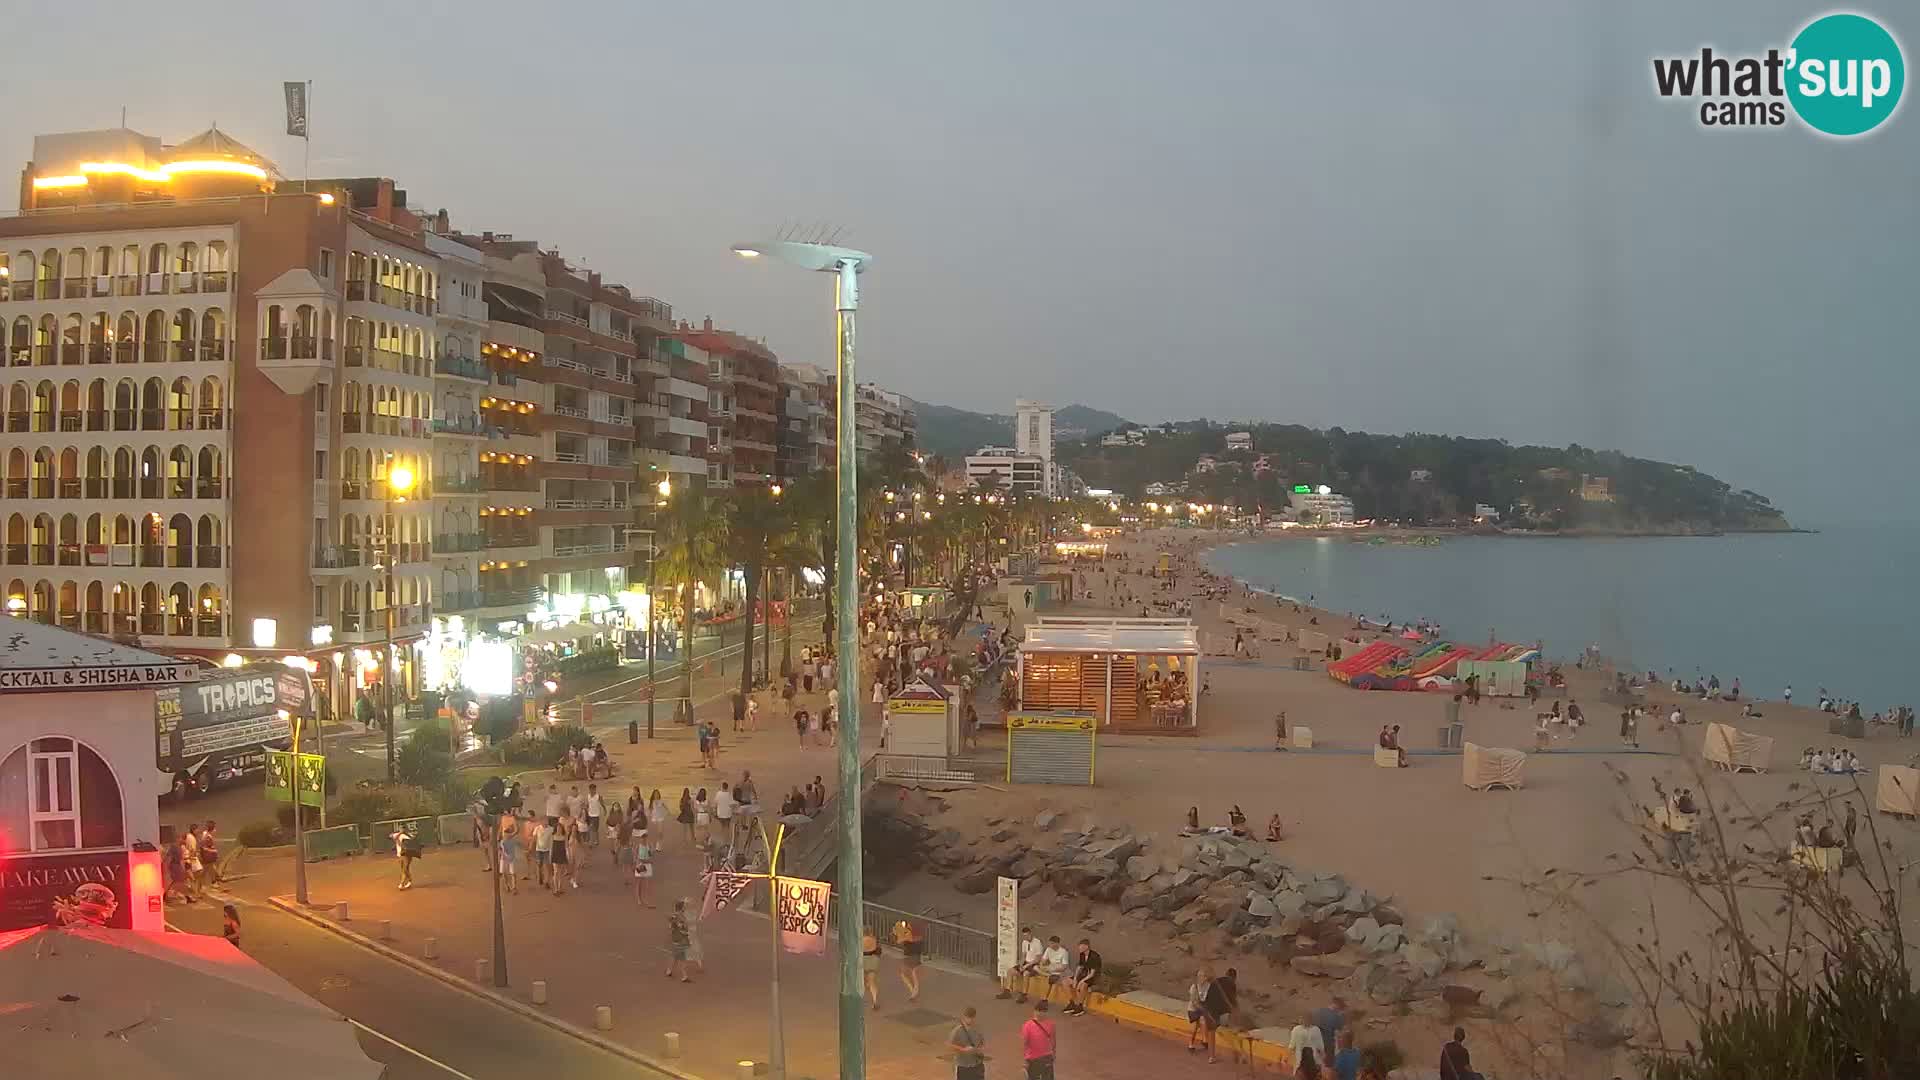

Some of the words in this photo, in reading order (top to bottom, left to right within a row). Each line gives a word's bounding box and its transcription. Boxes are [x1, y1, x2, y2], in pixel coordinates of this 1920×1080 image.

[63, 670, 73, 684] &
[79, 668, 140, 684] SHISHA
[145, 666, 178, 681] BAR
[779, 914, 825, 937] RESPECT
